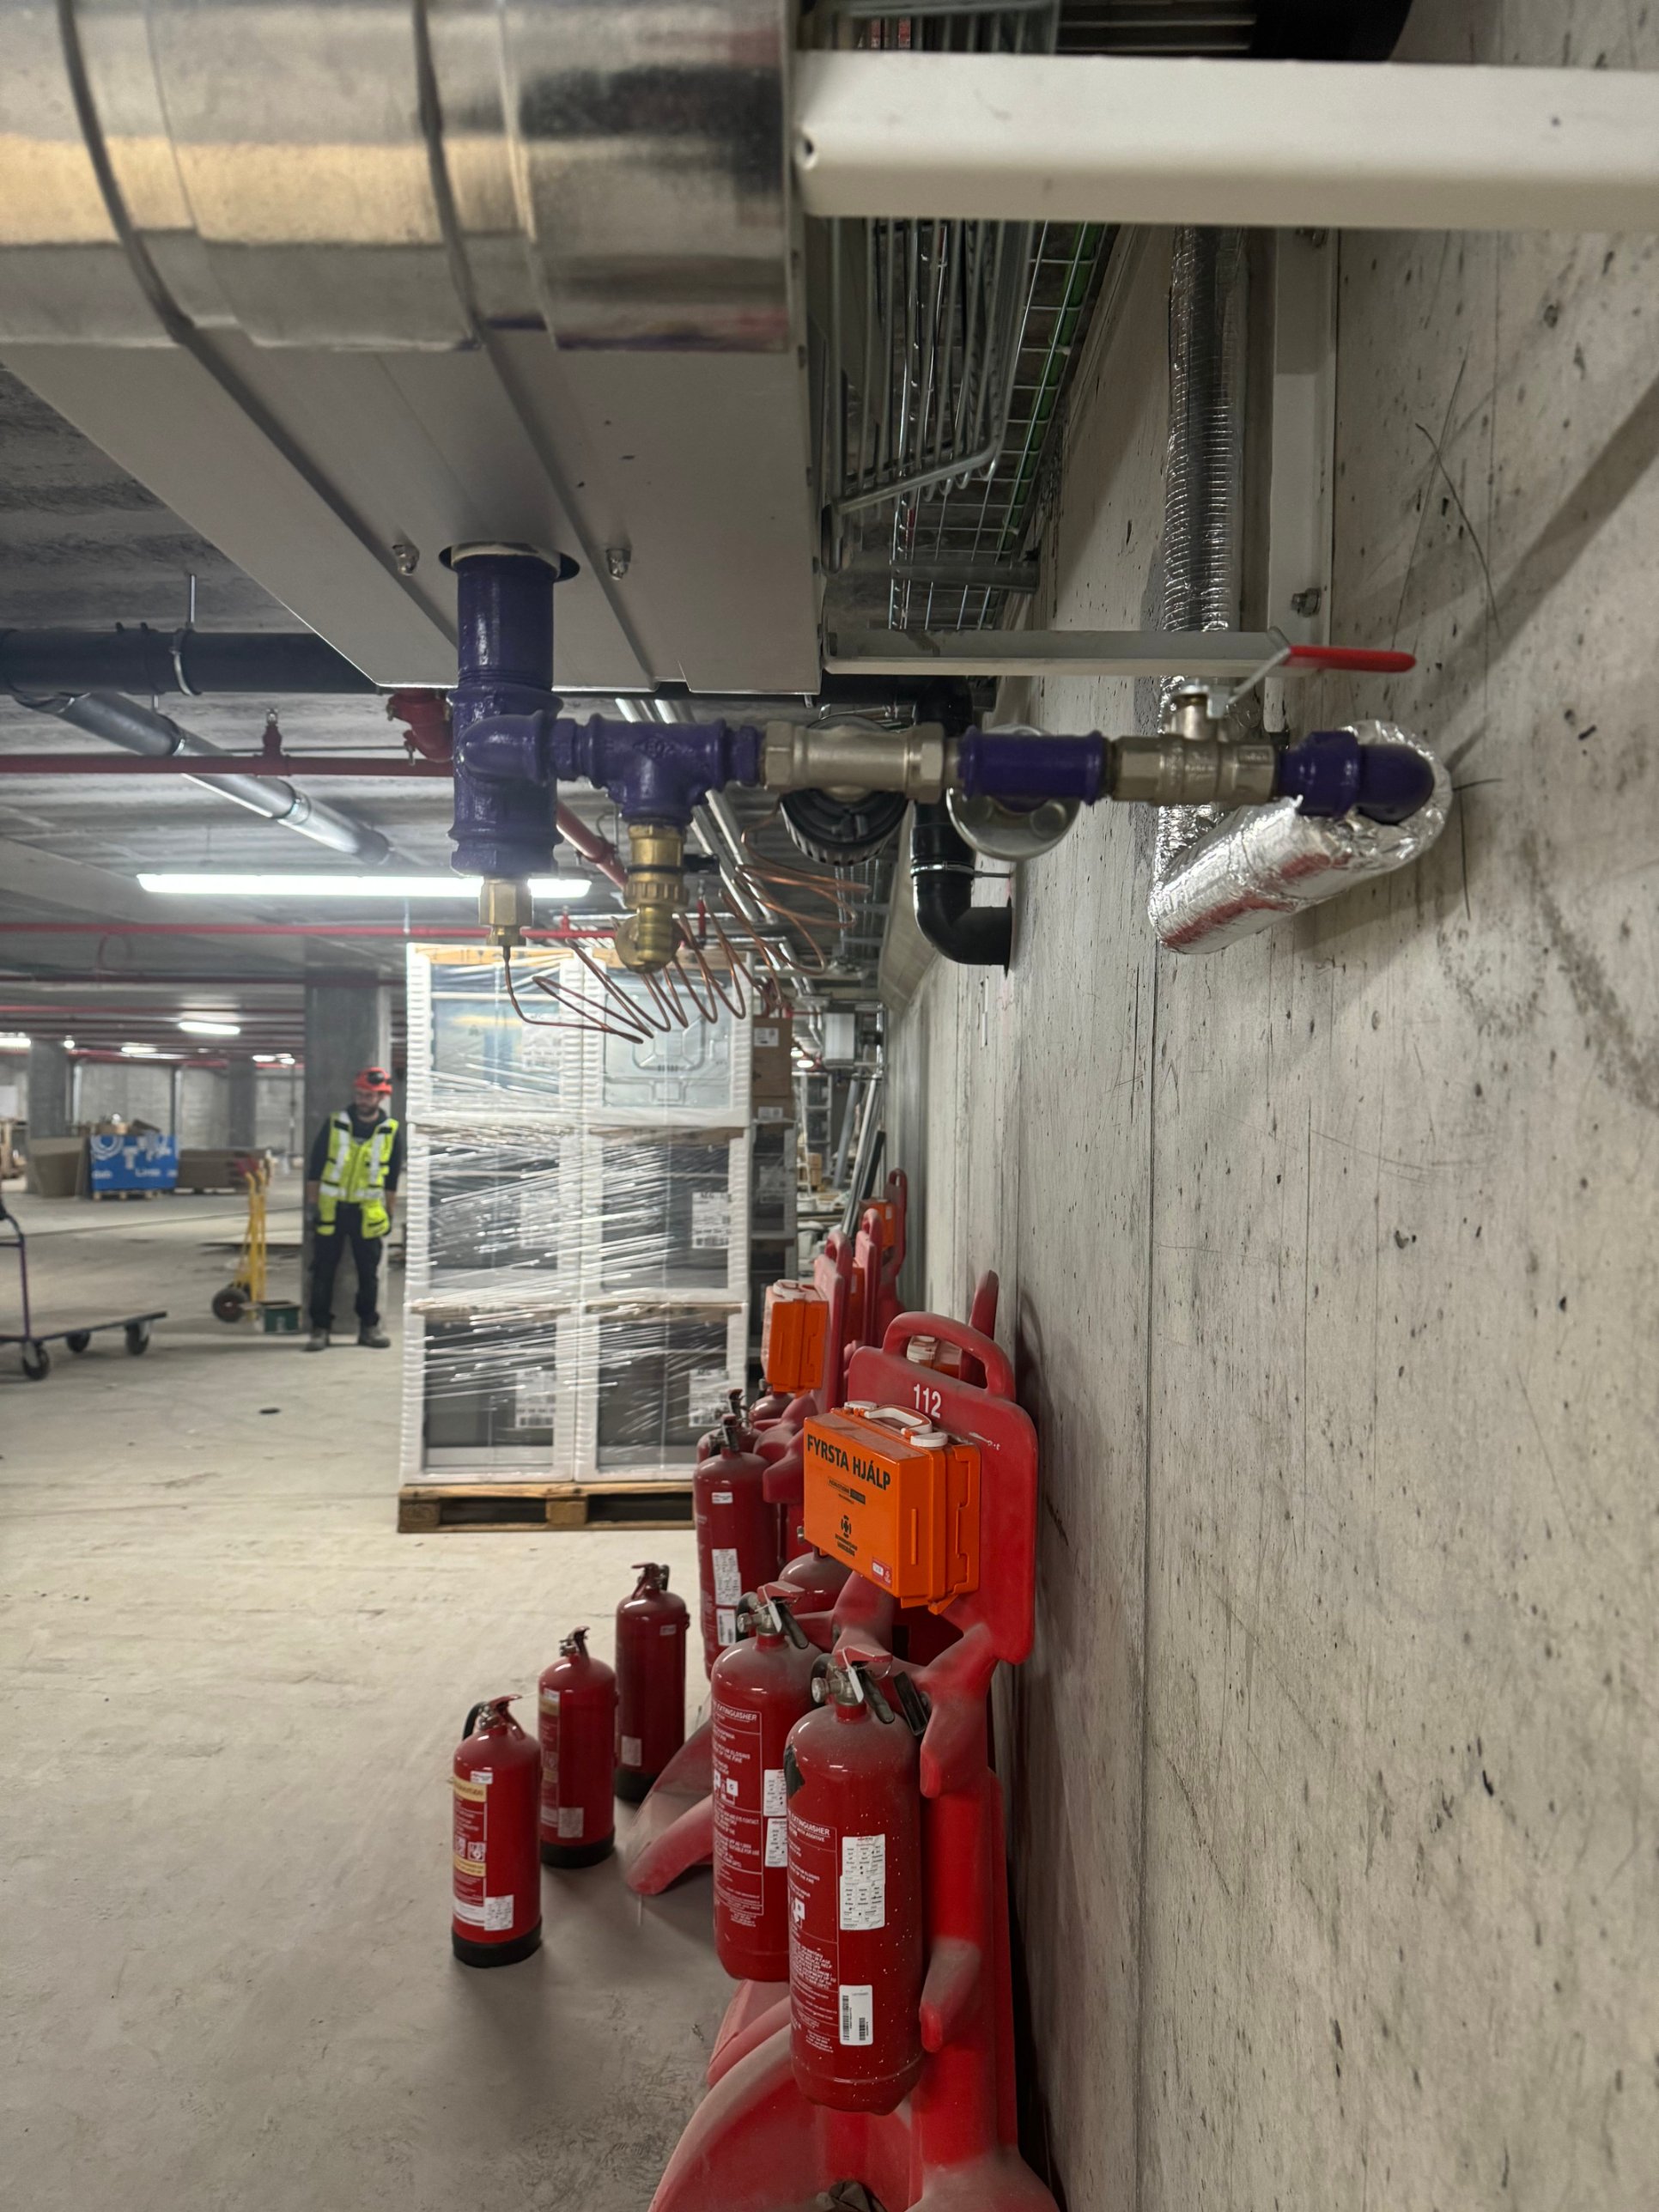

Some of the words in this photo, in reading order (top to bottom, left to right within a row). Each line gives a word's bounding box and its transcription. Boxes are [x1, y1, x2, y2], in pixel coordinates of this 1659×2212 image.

[913, 1383, 942, 1419] 112
[807, 1433, 849, 1472] FYRSTA
[853, 1455, 891, 1491] HJÁLP
[790, 1813, 830, 1836] EXTINGUISHER
